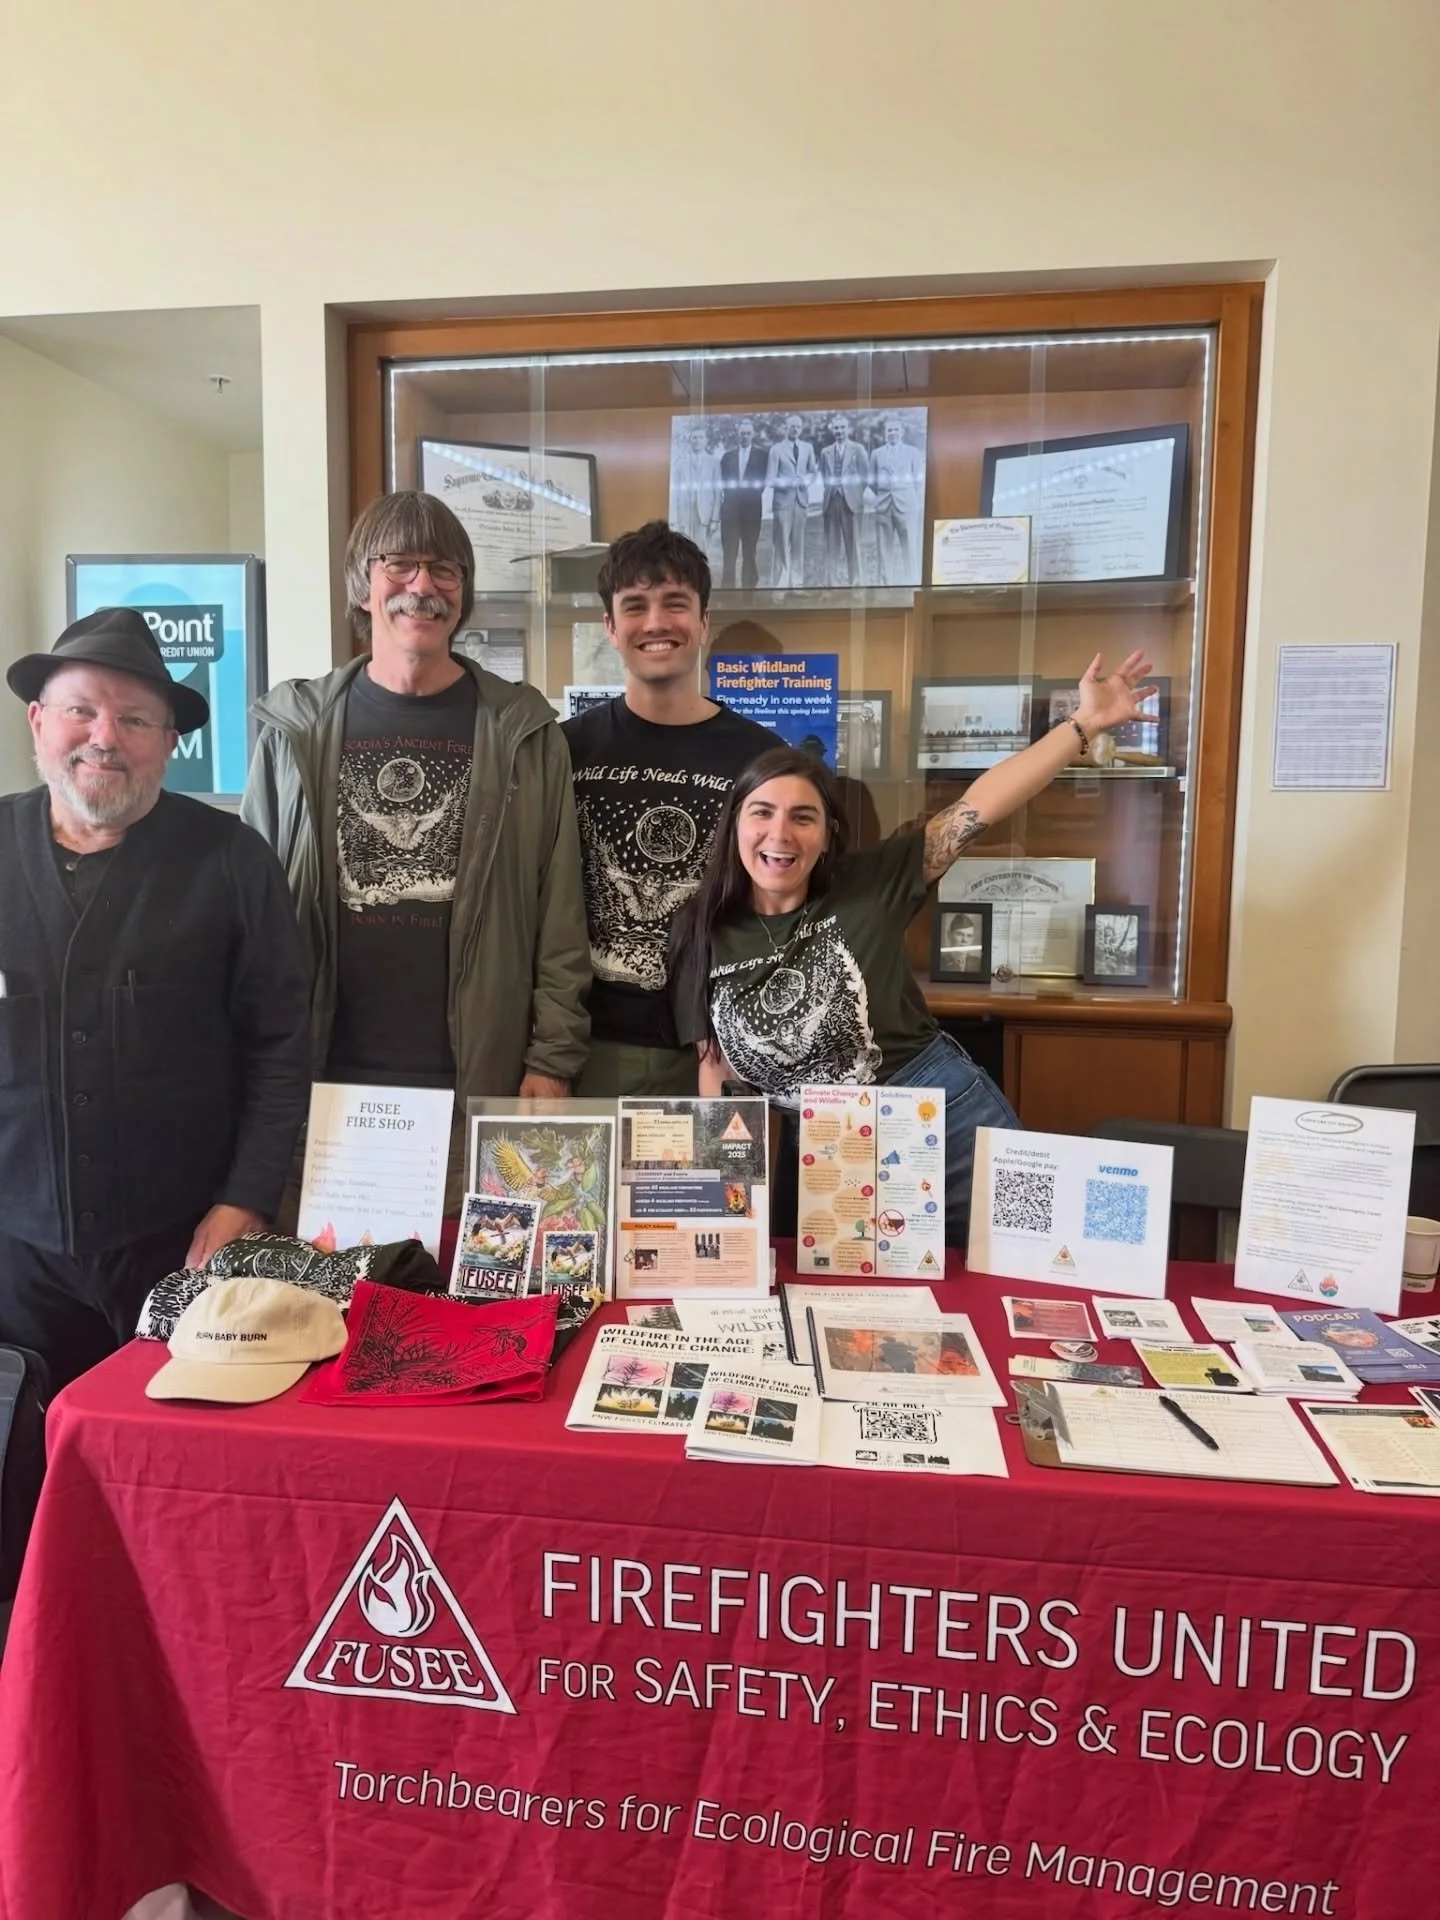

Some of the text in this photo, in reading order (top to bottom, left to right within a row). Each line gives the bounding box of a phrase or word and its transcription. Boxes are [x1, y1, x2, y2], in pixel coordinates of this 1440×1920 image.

[145, 610, 215, 644] Point
[160, 646, 215, 658] REDIT UNION
[716, 660, 806, 673] Basic Wildland
[716, 676, 832, 691] Firefighter Training
[716, 694, 833, 707] Fire-ready in one week
[790, 707, 811, 716] spring
[344, 735, 474, 755] SCADIA'S ANCIENT FORE
[572, 765, 734, 792] Wild Life Needs Wild
[350, 912, 387, 925] BORN
[391, 914, 405, 924] IN
[814, 914, 838, 934] Fire
[803, 1088, 859, 1098] Climate Change
[818, 1096, 847, 1105] Wildfire
[359, 1101, 402, 1116] FUSEE
[346, 1116, 416, 1131] FIRE SHOP
[722, 1143, 752, 1151] IMPACT
[1005, 1147, 1051, 1159] Credit/debit
[992, 1156, 1042, 1169] Apple/Google
[1098, 1165, 1138, 1177] venmo
[466, 1267, 514, 1292] FUSEE
[1293, 1312, 1361, 1323] PODCAST
[718, 1320, 785, 1334] WILDFI
[195, 1331, 268, 1342] BURN BABY BURN
[600, 1336, 621, 1346] OF
[621, 1337, 686, 1351] CLIMATE
[603, 1327, 754, 1346] WILDFIRE IN THE AGE
[710, 1371, 758, 1382] WILDFIRE
[772, 1380, 792, 1389] THE
[793, 1384, 812, 1392] AGE
[723, 1378, 767, 1390] CLIMATE
[614, 1416, 646, 1424] FOREST
[648, 1419, 682, 1428] CLIMATE
[542, 1551, 1418, 1702] FIREFIGHTERS UNITED
[316, 1639, 486, 1697] FUSEE
[538, 1656, 1410, 1784] FOR SAFETY, ETHICS & ECOLOGY
[333, 1760, 1342, 1917] Torchbearers for Ecological Fire Management
